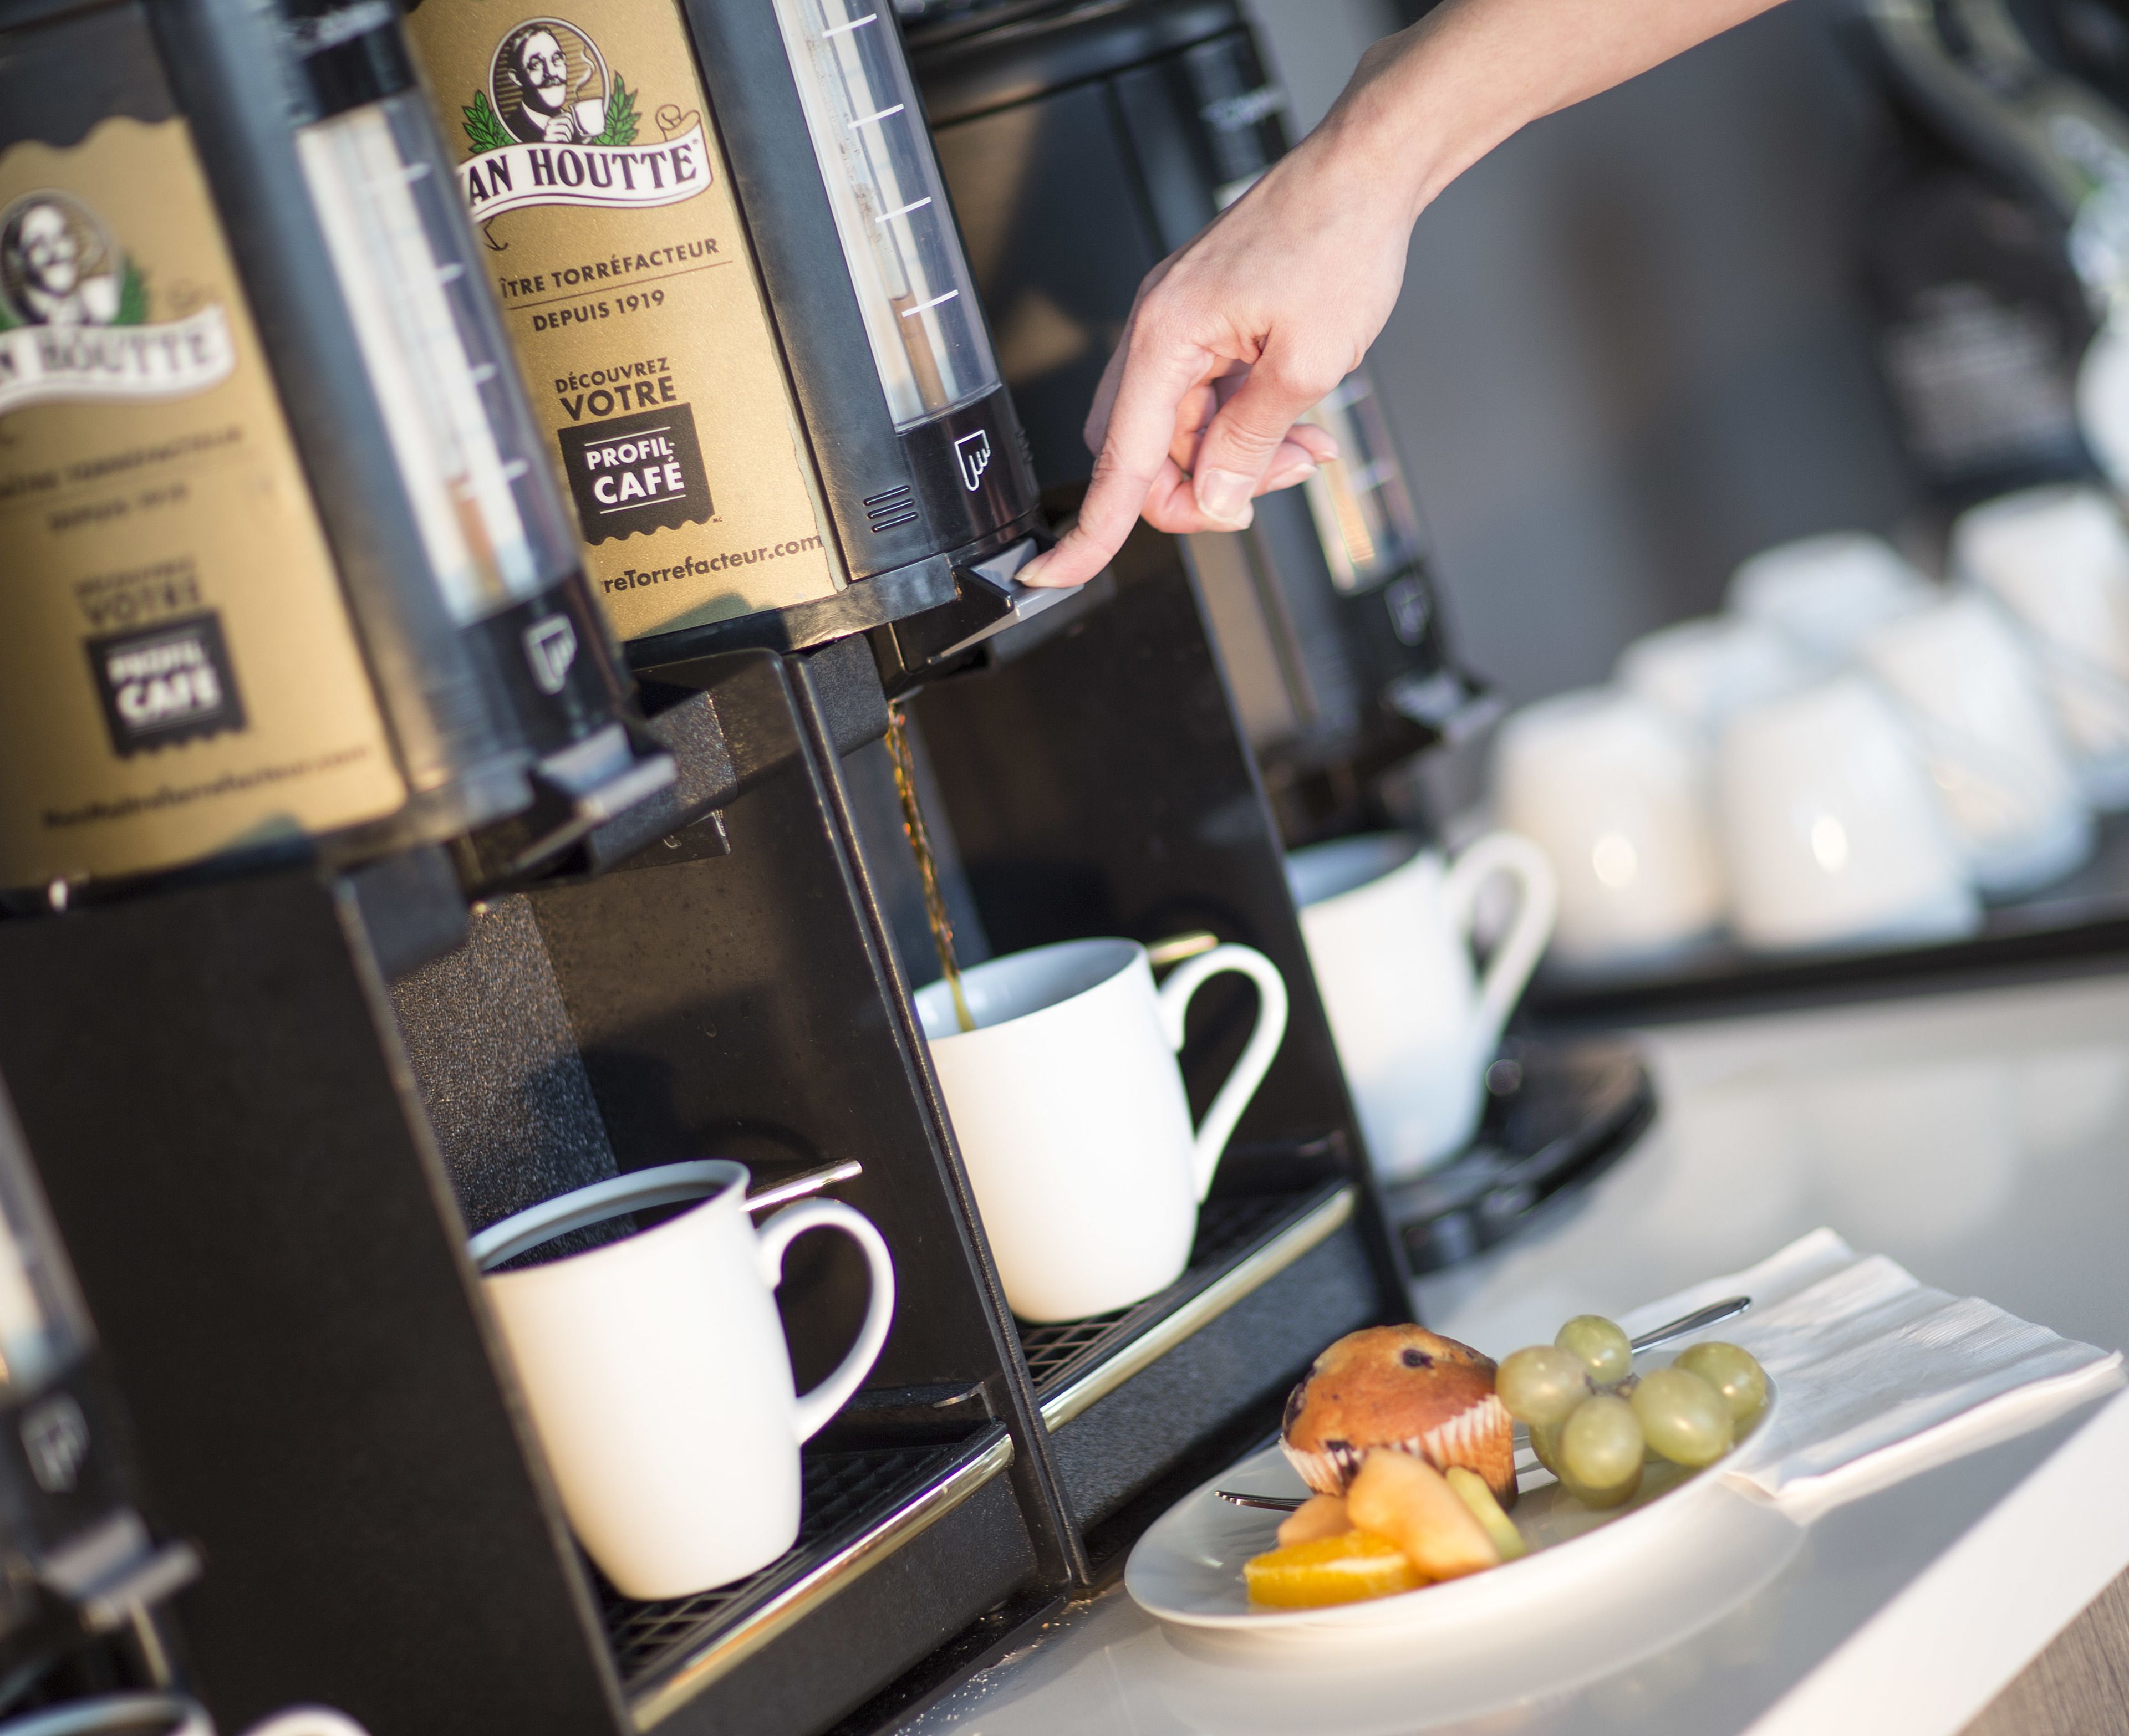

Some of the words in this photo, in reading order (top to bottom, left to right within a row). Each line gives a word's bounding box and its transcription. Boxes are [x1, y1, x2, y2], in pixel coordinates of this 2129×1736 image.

[461, 154, 513, 207] AN
[527, 143, 696, 190] HOUTTE
[551, 238, 719, 288] TORRÉFACTEUR
[533, 302, 610, 331] DEPUIS
[615, 289, 664, 314] 1919
[555, 356, 670, 393] DÉCOUVREZ
[559, 375, 677, 421] VOTRE
[594, 456, 685, 504] CAFÉ
